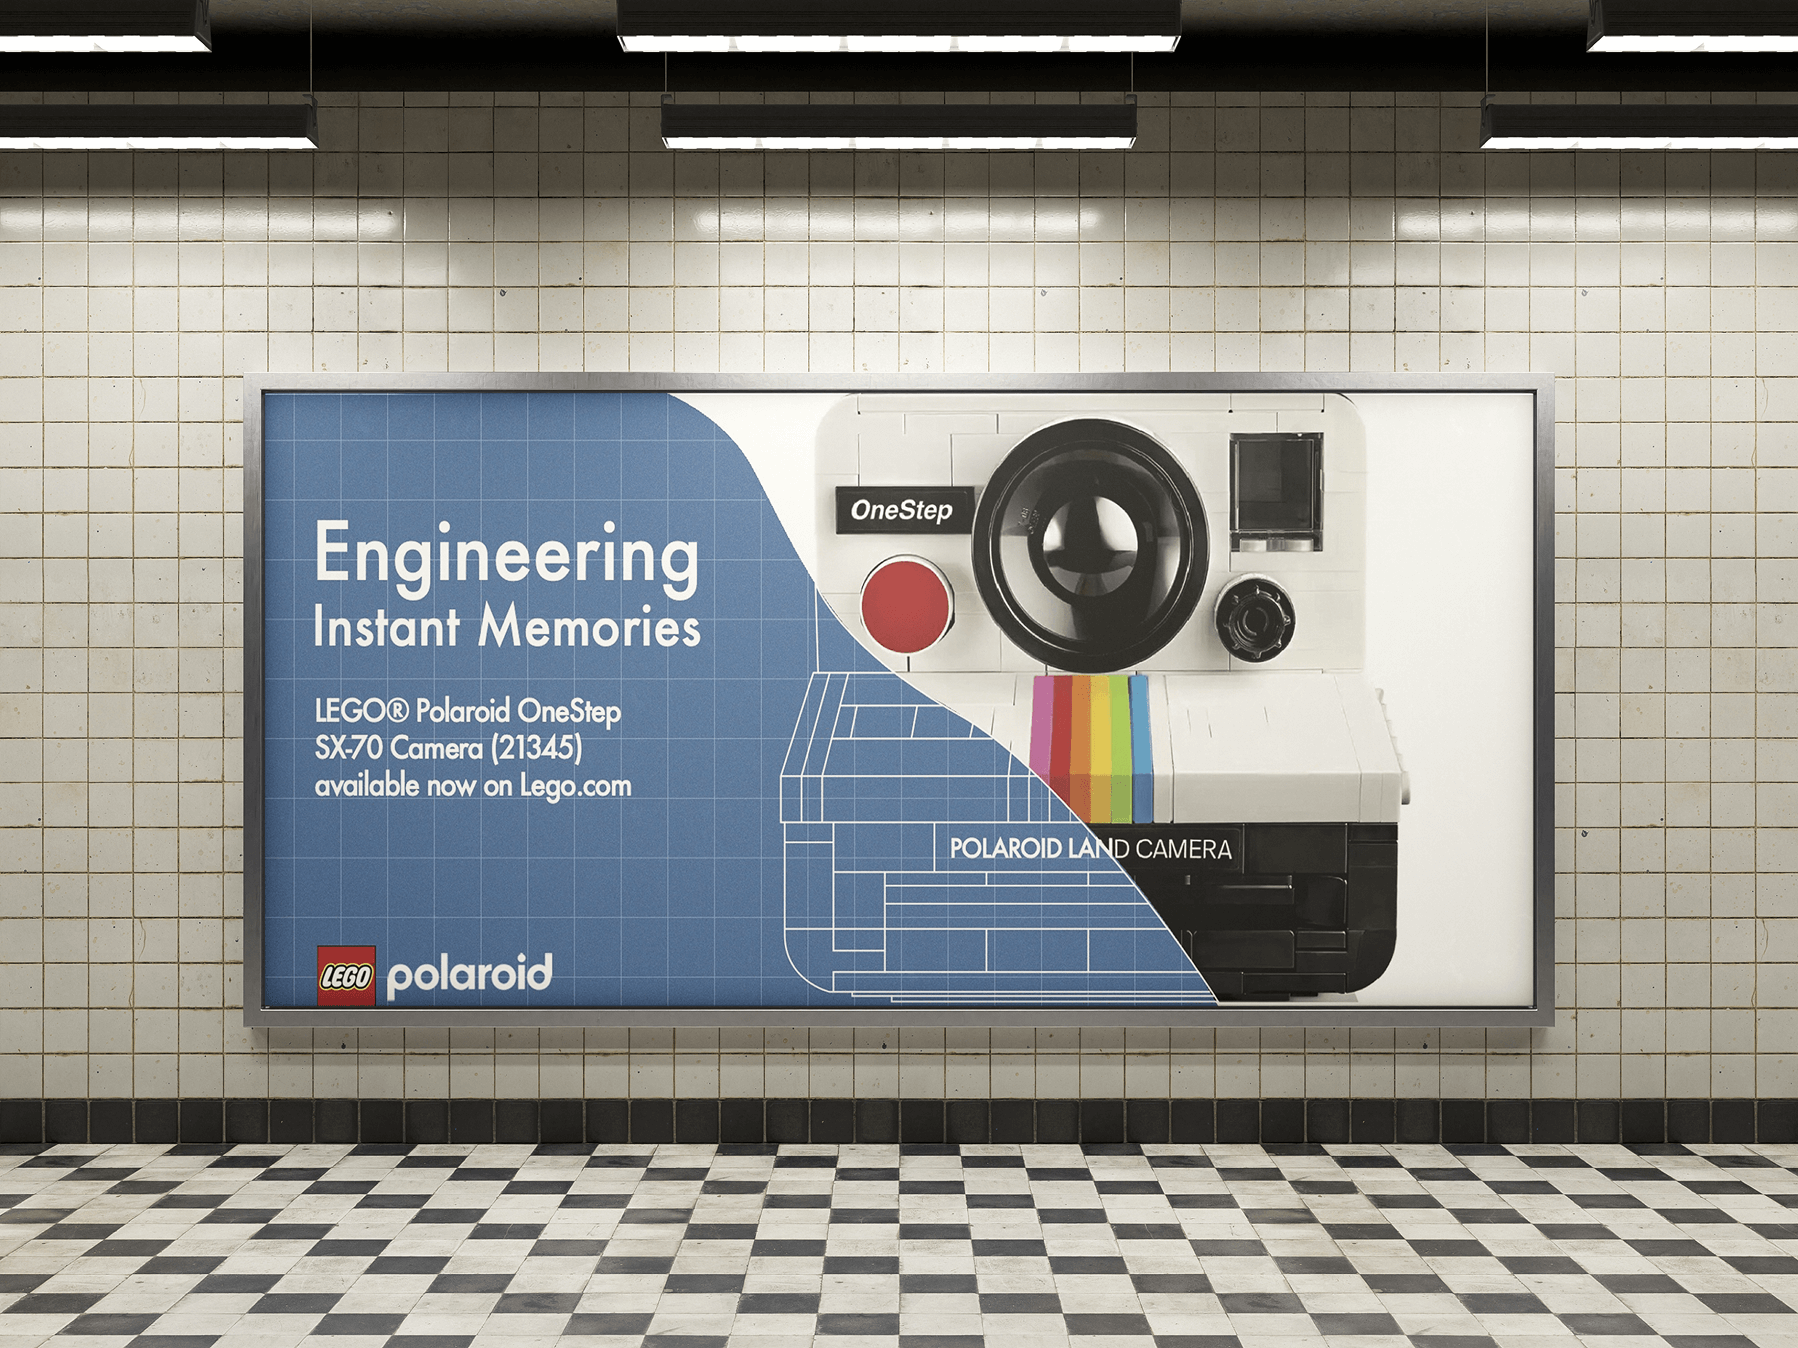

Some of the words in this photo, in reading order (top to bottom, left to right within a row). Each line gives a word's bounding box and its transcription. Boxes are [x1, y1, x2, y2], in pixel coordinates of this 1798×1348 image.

[851, 498, 953, 525] OneStep
[316, 519, 698, 602] Engineering
[314, 603, 461, 647] Instant
[477, 600, 701, 648] Memories
[315, 697, 410, 723] LEGO®
[416, 695, 510, 723] Polaroid
[517, 697, 622, 730] OneStep
[315, 734, 384, 760] SX-70
[390, 734, 483, 760] Camera
[491, 732, 582, 766] (21345)
[314, 769, 420, 797] available
[427, 778, 477, 797] now
[483, 778, 513, 797] on
[520, 771, 632, 804] Lego.com
[950, 836, 1063, 859] POLAROID
[1068, 836, 1130, 860] LAND
[1135, 838, 1233, 860] CAMERA
[319, 963, 373, 990] LEGO
[386, 952, 553, 1001] polaroid
